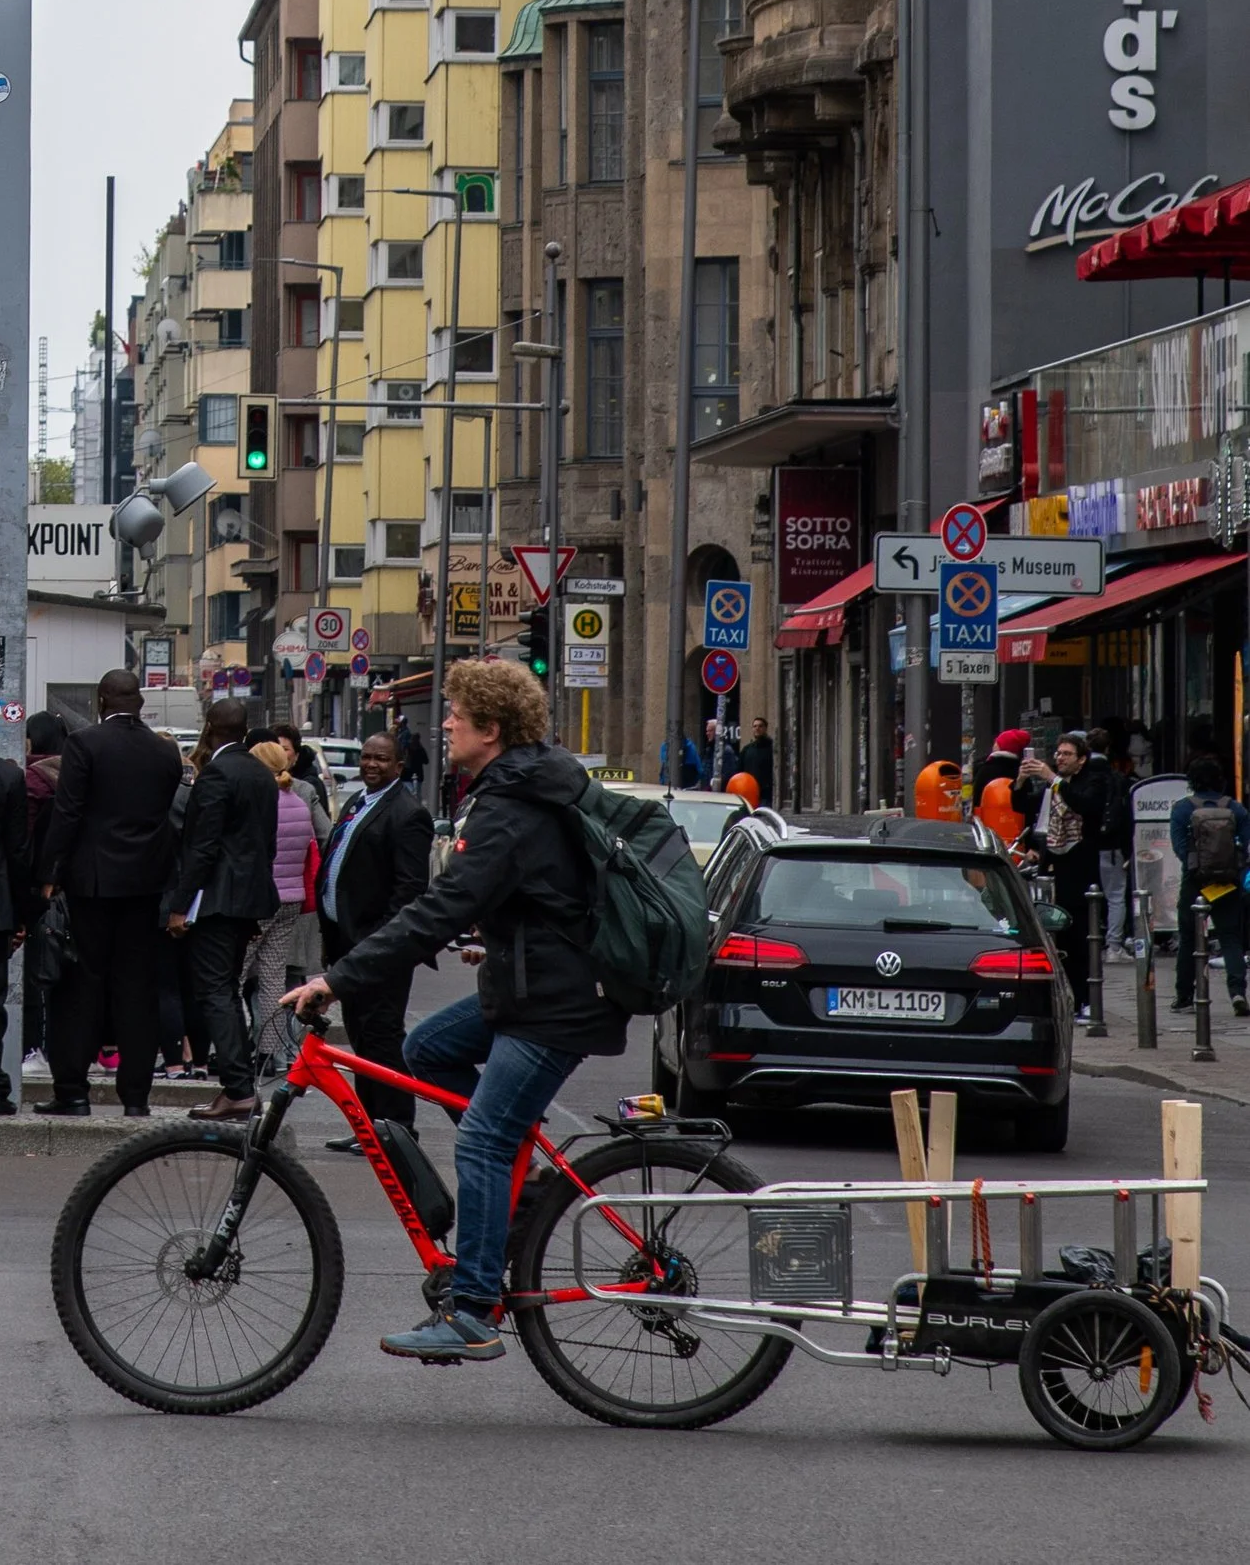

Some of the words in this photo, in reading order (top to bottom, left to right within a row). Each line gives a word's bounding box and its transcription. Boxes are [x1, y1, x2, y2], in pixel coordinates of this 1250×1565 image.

[1029, 173, 1218, 246] McCaf
[1152, 334, 1190, 449] SNACKS
[786, 517, 851, 533] SOTTO
[27, 523, 104, 556] KPOINT
[786, 534, 851, 550] SOPRA
[794, 557, 842, 566] Trattoria
[1012, 556, 1076, 576] Museum
[465, 586, 482, 594] CAS
[574, 580, 617, 592] Kochstraße
[321, 618, 338, 632] 30
[581, 616, 594, 632] H
[709, 628, 745, 644] TAXI
[945, 624, 991, 643] TAXI
[946, 660, 953, 673] 5
[958, 660, 990, 674] Taxen
[597, 770, 624, 780] TAXI
[1137, 800, 1169, 811] SNACKS
[840, 990, 864, 1009] KM
[878, 991, 889, 1009] L
[894, 992, 942, 1012] 1109
